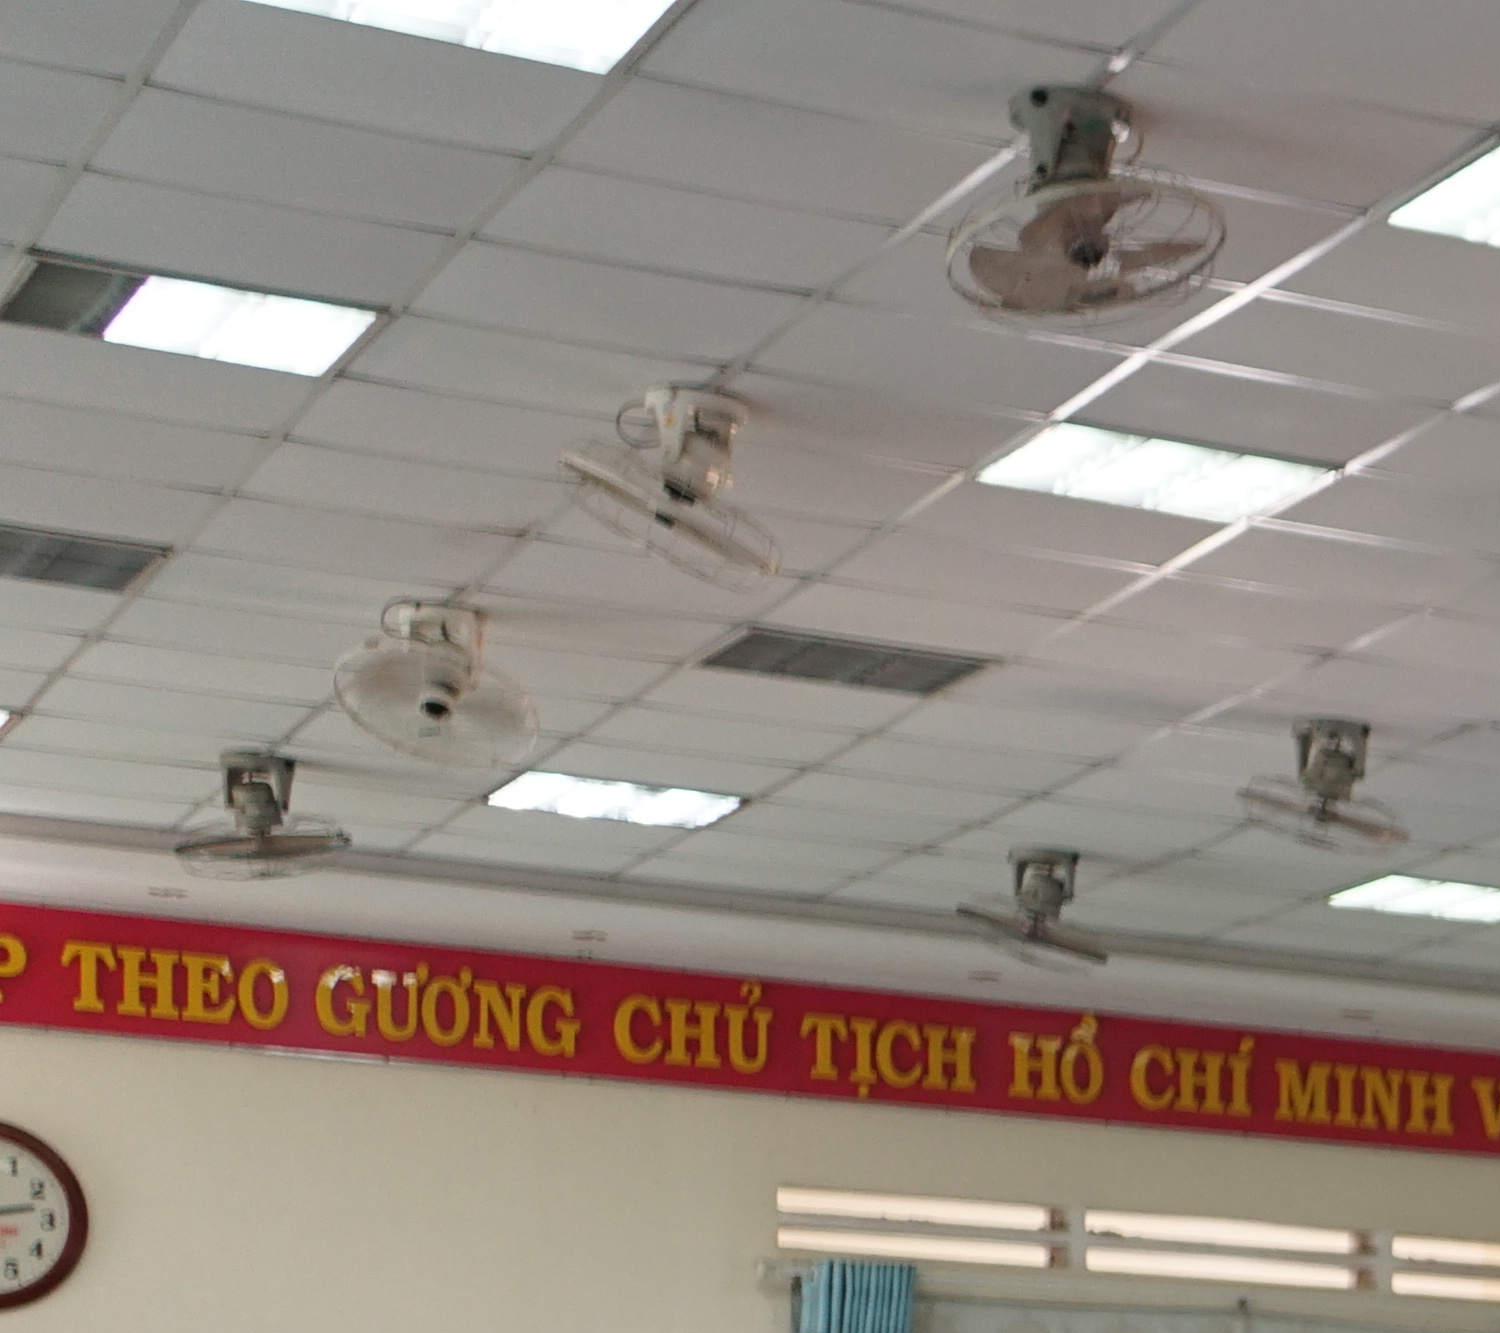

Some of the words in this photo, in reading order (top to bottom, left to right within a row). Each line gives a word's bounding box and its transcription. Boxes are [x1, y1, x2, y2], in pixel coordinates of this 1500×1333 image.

[61, 939, 290, 1031] THEO
[315, 960, 581, 1058] GƯƠNG
[613, 979, 774, 1074] CHỦ
[799, 1011, 977, 1099] TỊCH
[1129, 1034, 1256, 1118] CHÍ
[1273, 1057, 1456, 1137] MINH
